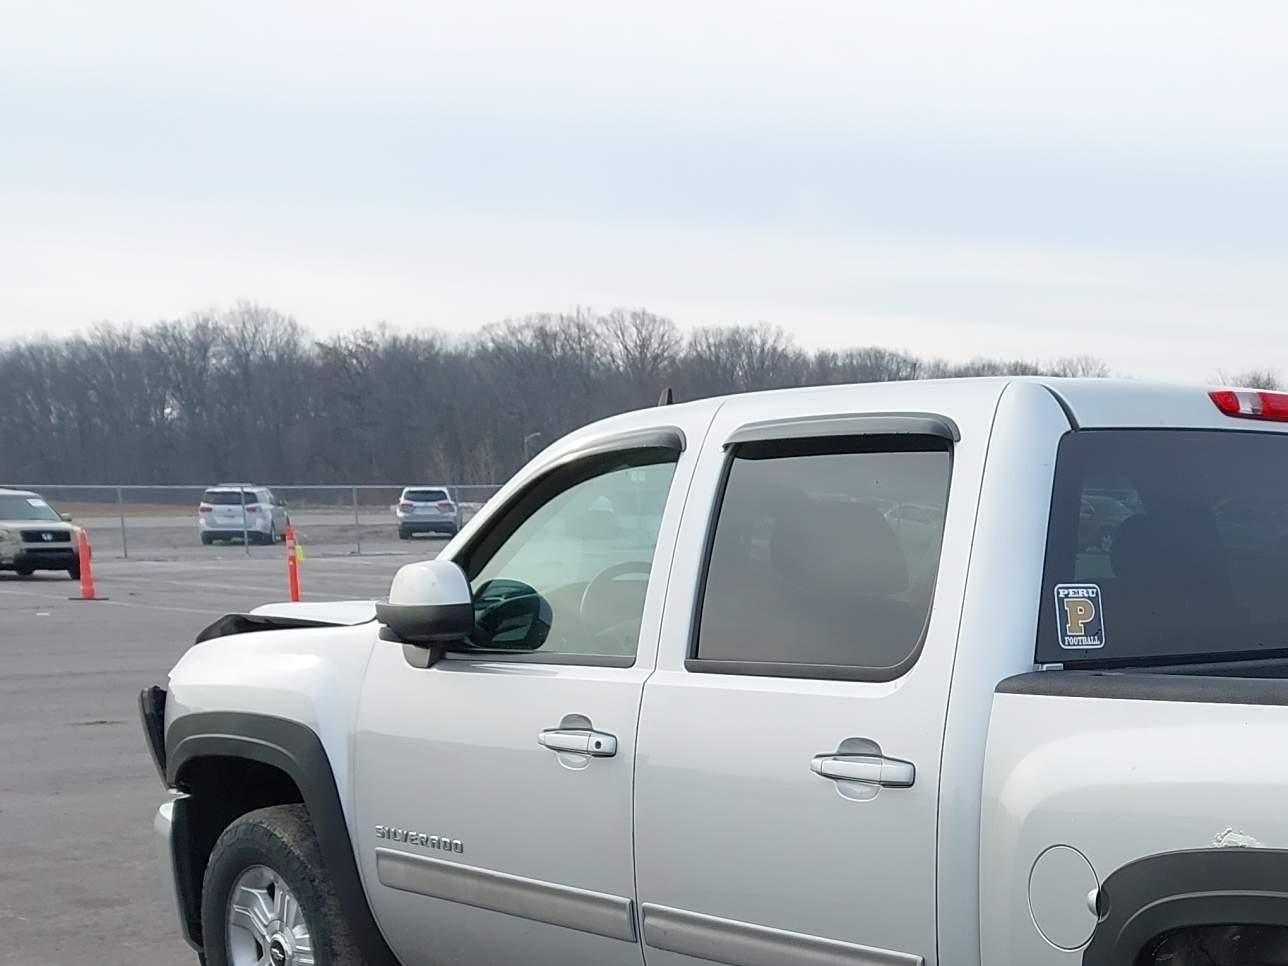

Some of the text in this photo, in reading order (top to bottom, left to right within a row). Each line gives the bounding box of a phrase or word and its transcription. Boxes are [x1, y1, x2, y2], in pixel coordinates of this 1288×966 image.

[1058, 588, 1097, 598] PERU
[1064, 598, 1095, 635] P
[1064, 635, 1101, 646] FOOTBALL
[375, 825, 464, 854] SILVERADO
